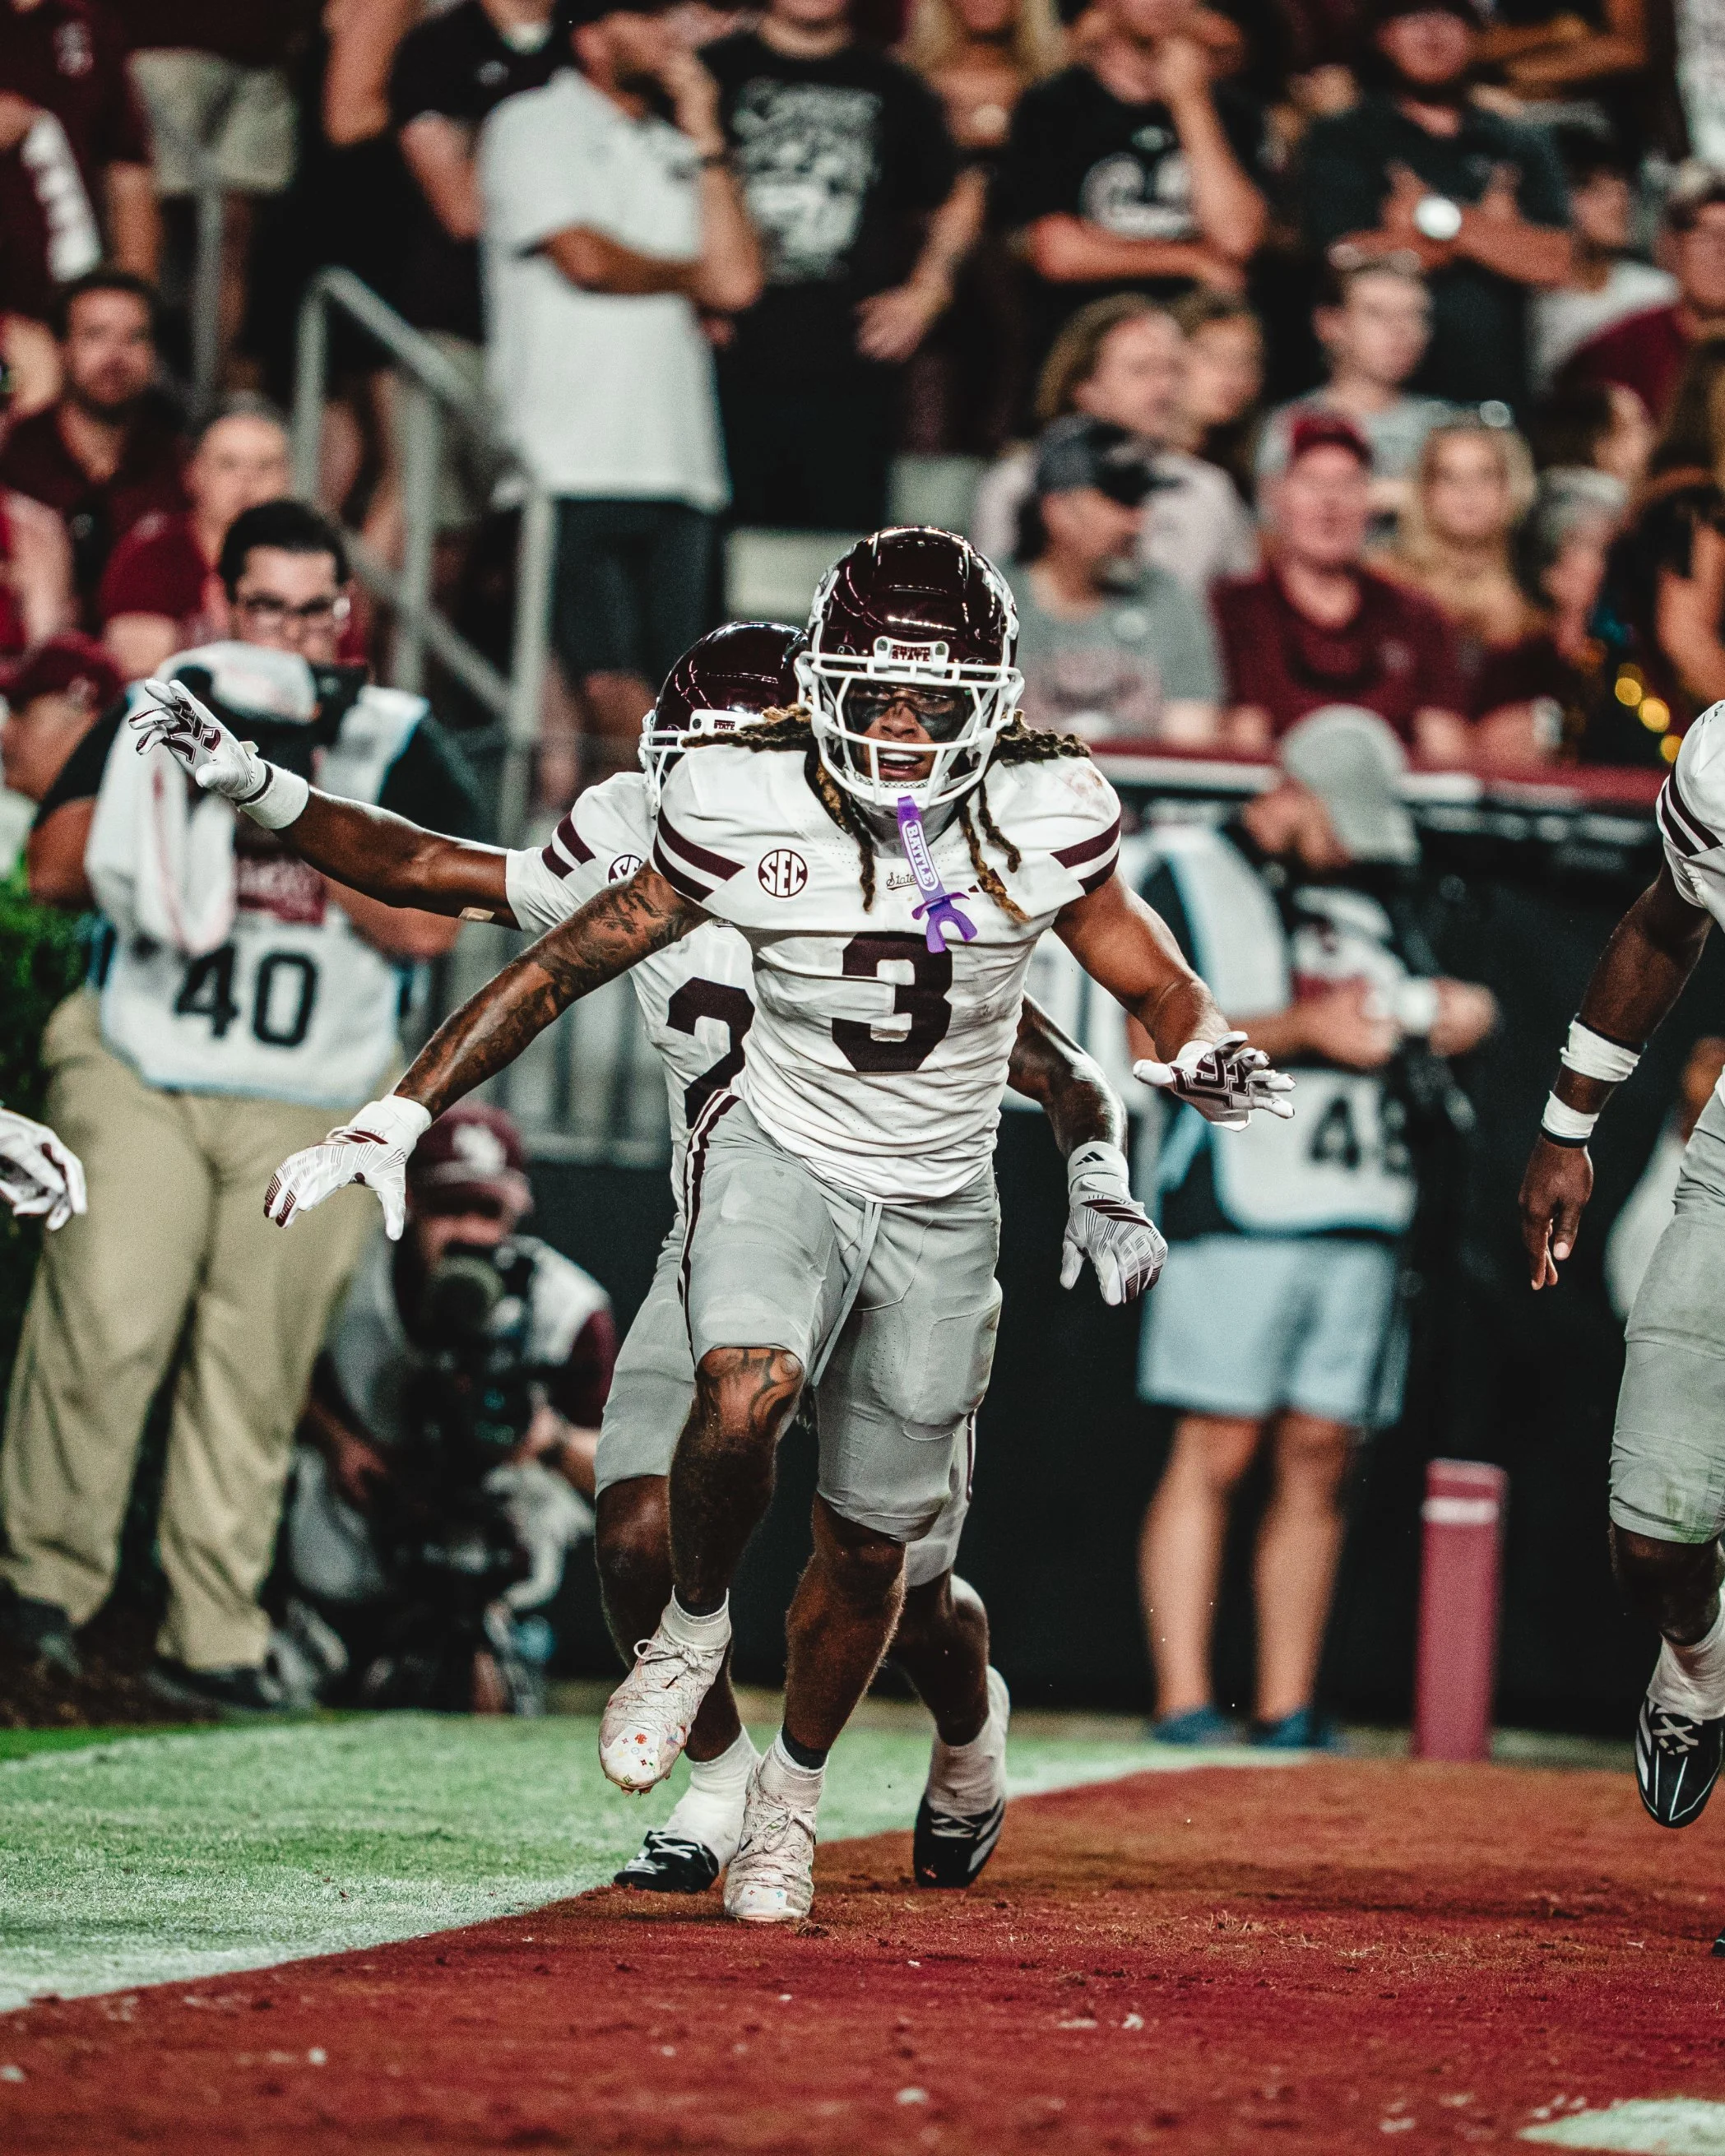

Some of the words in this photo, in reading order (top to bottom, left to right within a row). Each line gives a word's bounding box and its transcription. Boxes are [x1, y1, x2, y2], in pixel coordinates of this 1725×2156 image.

[609, 855, 643, 883] SE
[758, 849, 808, 897] SEC
[886, 872, 916, 889] State
[906, 824, 934, 885] BATTLE
[174, 944, 319, 1047] 40
[832, 931, 953, 1072] 3
